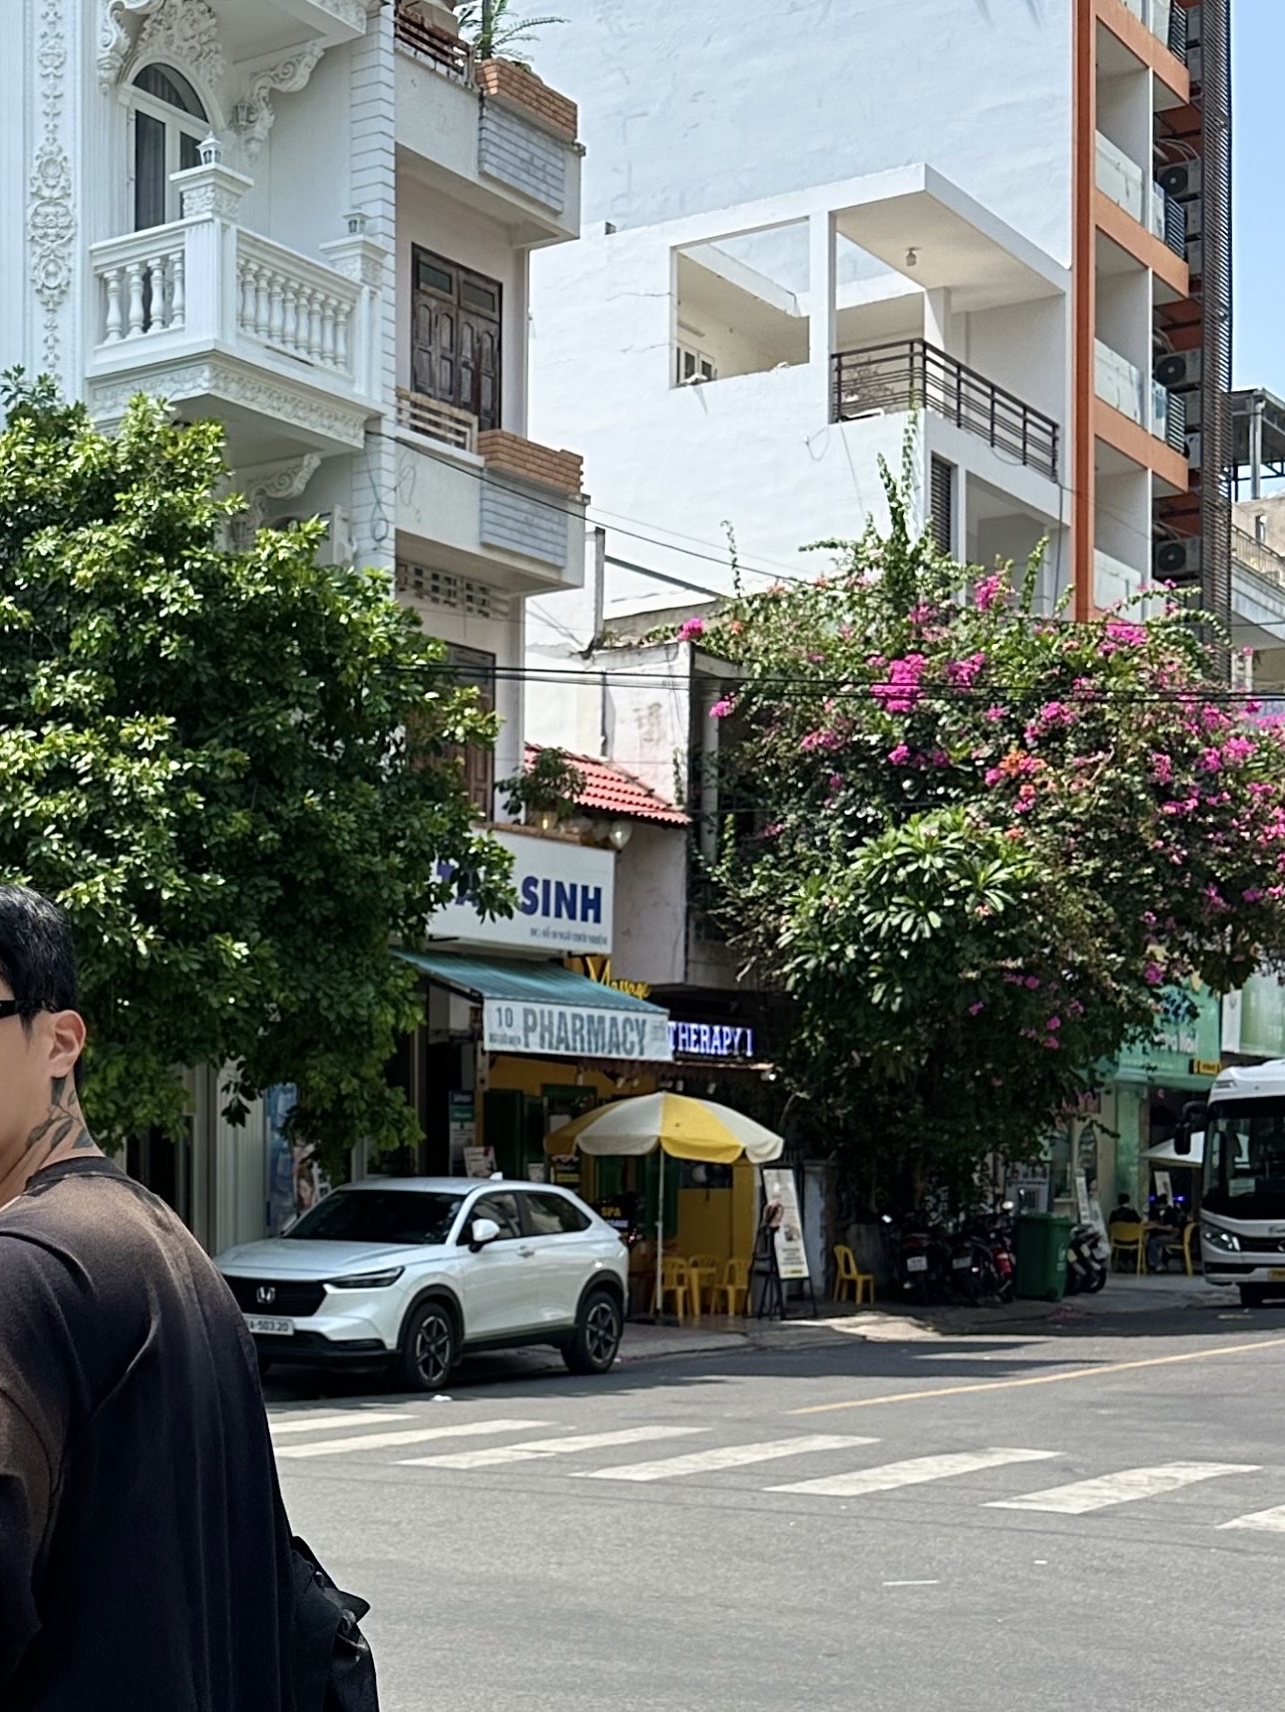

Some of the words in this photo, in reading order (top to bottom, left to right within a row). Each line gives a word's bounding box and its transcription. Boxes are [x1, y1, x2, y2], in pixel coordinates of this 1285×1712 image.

[520, 875, 602, 924] SINH
[496, 1007, 514, 1028] 10
[523, 1007, 647, 1057] PHARMACY
[667, 1021, 742, 1056] THERAPY
[601, 1206, 622, 1217] SPA
